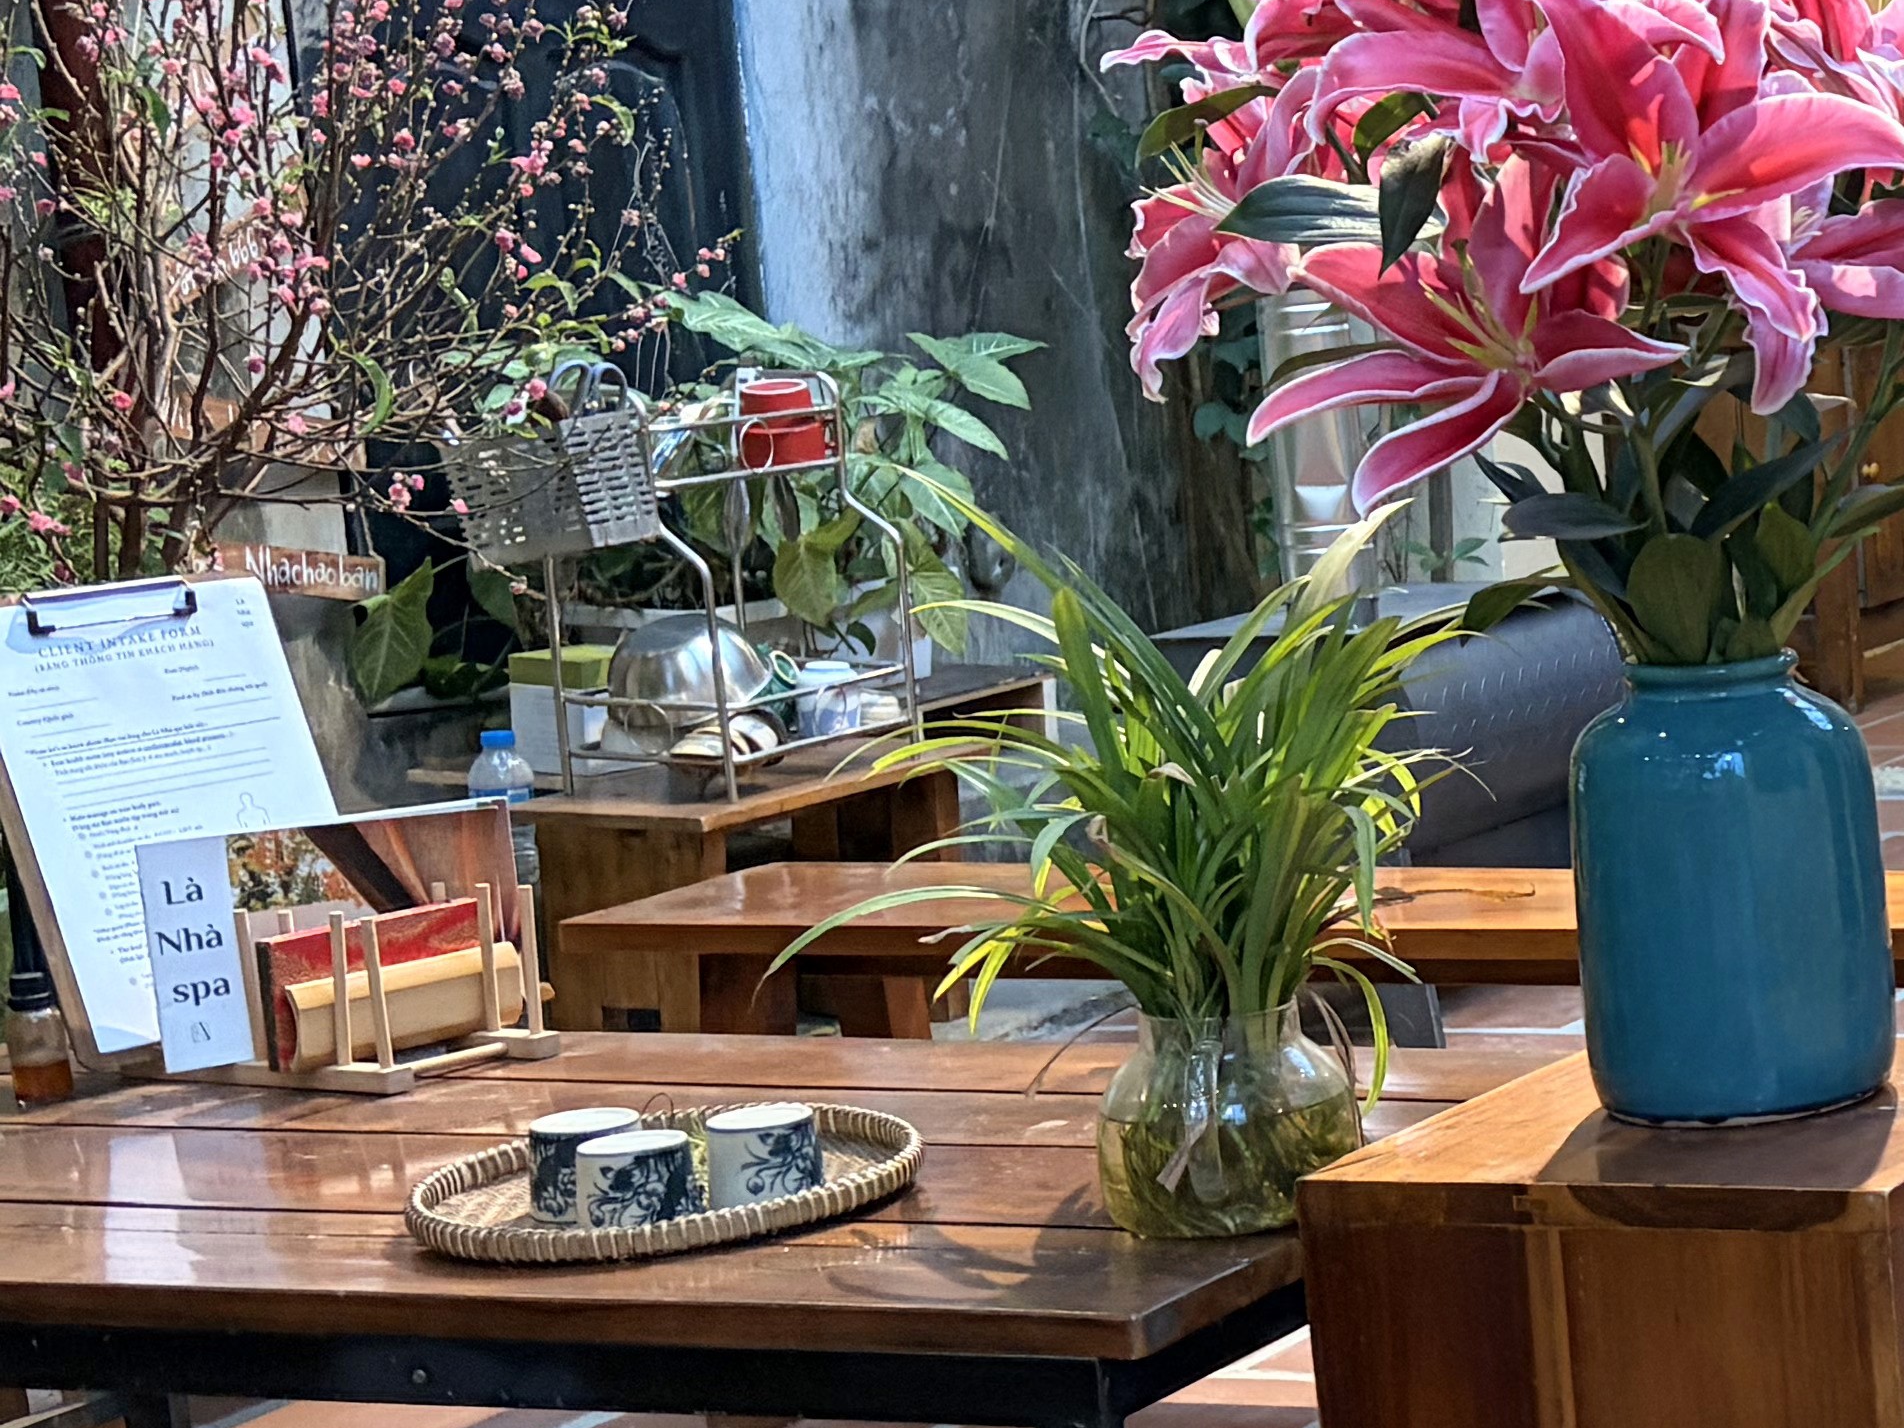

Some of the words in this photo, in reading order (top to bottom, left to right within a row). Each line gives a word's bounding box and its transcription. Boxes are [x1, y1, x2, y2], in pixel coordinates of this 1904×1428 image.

[161, 876, 204, 906] Là
[154, 923, 224, 957] Nhà
[172, 977, 231, 1006] spa
